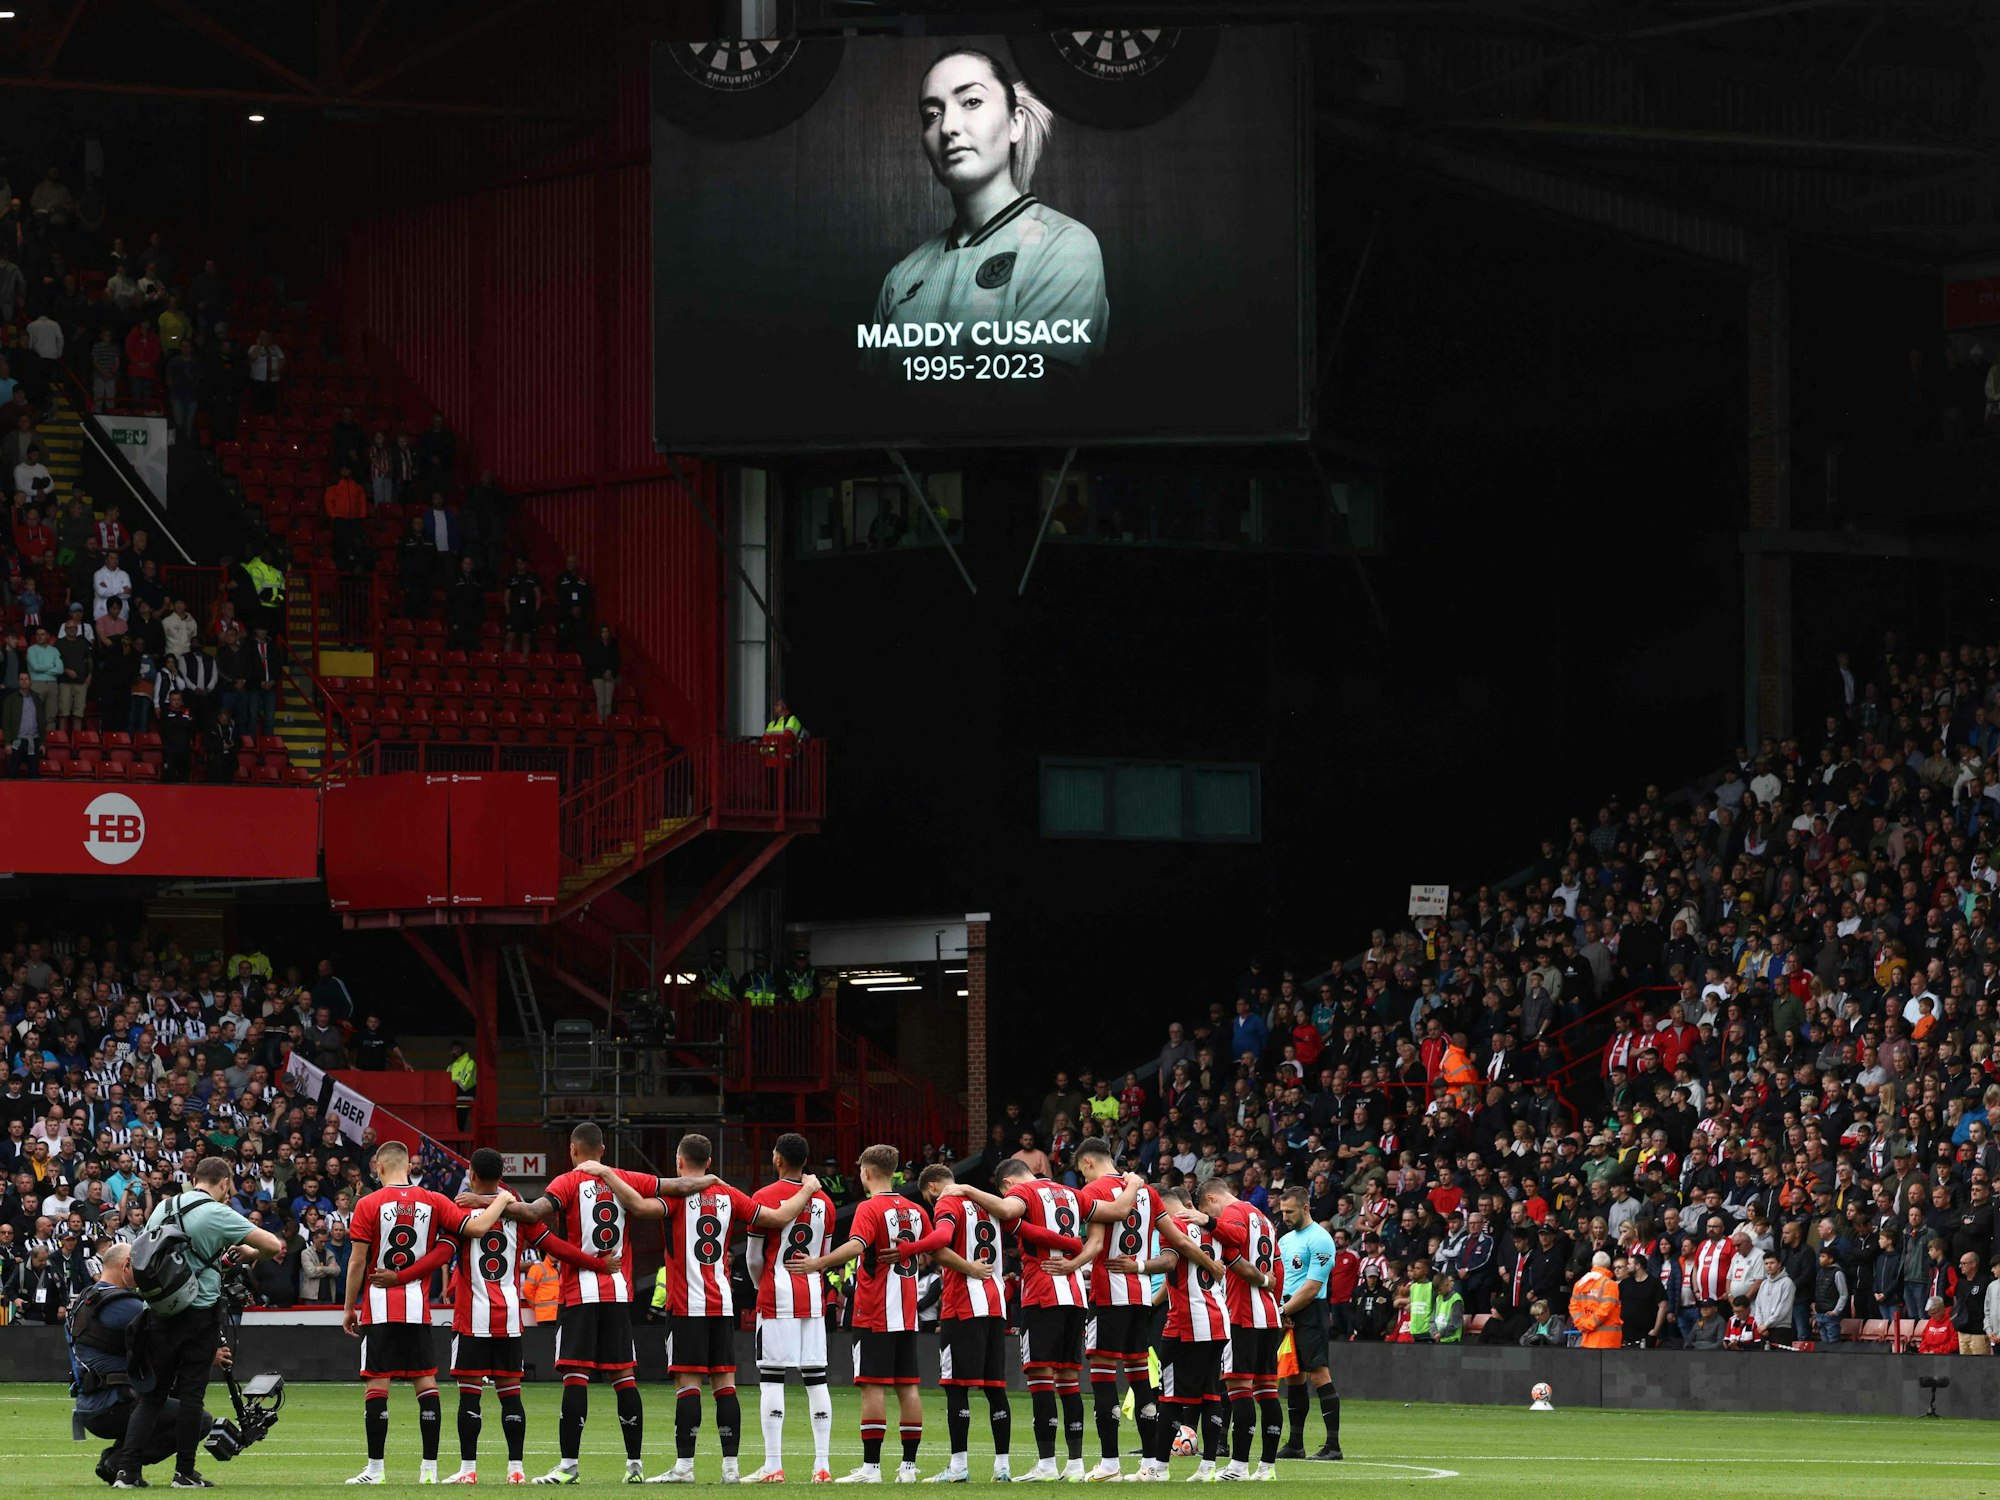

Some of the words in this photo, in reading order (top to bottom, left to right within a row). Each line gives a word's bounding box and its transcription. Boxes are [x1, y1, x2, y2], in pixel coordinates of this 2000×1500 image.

[857, 321, 963, 348] MADDY
[971, 318, 1091, 346] CUSACK
[902, 353, 1043, 381] 1995-2023
[333, 1096, 365, 1127] ABER
[523, 1156, 538, 1174] M
[382, 1203, 429, 1223] CUSACK
[583, 1184, 611, 1199] CUSA
[688, 1195, 728, 1212] CUSACK
[592, 1201, 620, 1251] 8
[693, 1214, 722, 1265] 8
[890, 1209, 920, 1227] CUSACK
[1055, 1206, 1075, 1255] 8
[1119, 1208, 1142, 1256] 8
[383, 1224, 417, 1272] 8
[479, 1230, 507, 1281] 8
[783, 1223, 813, 1267] 8
[893, 1229, 918, 1278] 8
[974, 1220, 996, 1266] 8
[1255, 1234, 1273, 1274] 8
[1197, 1243, 1215, 1291] 8
